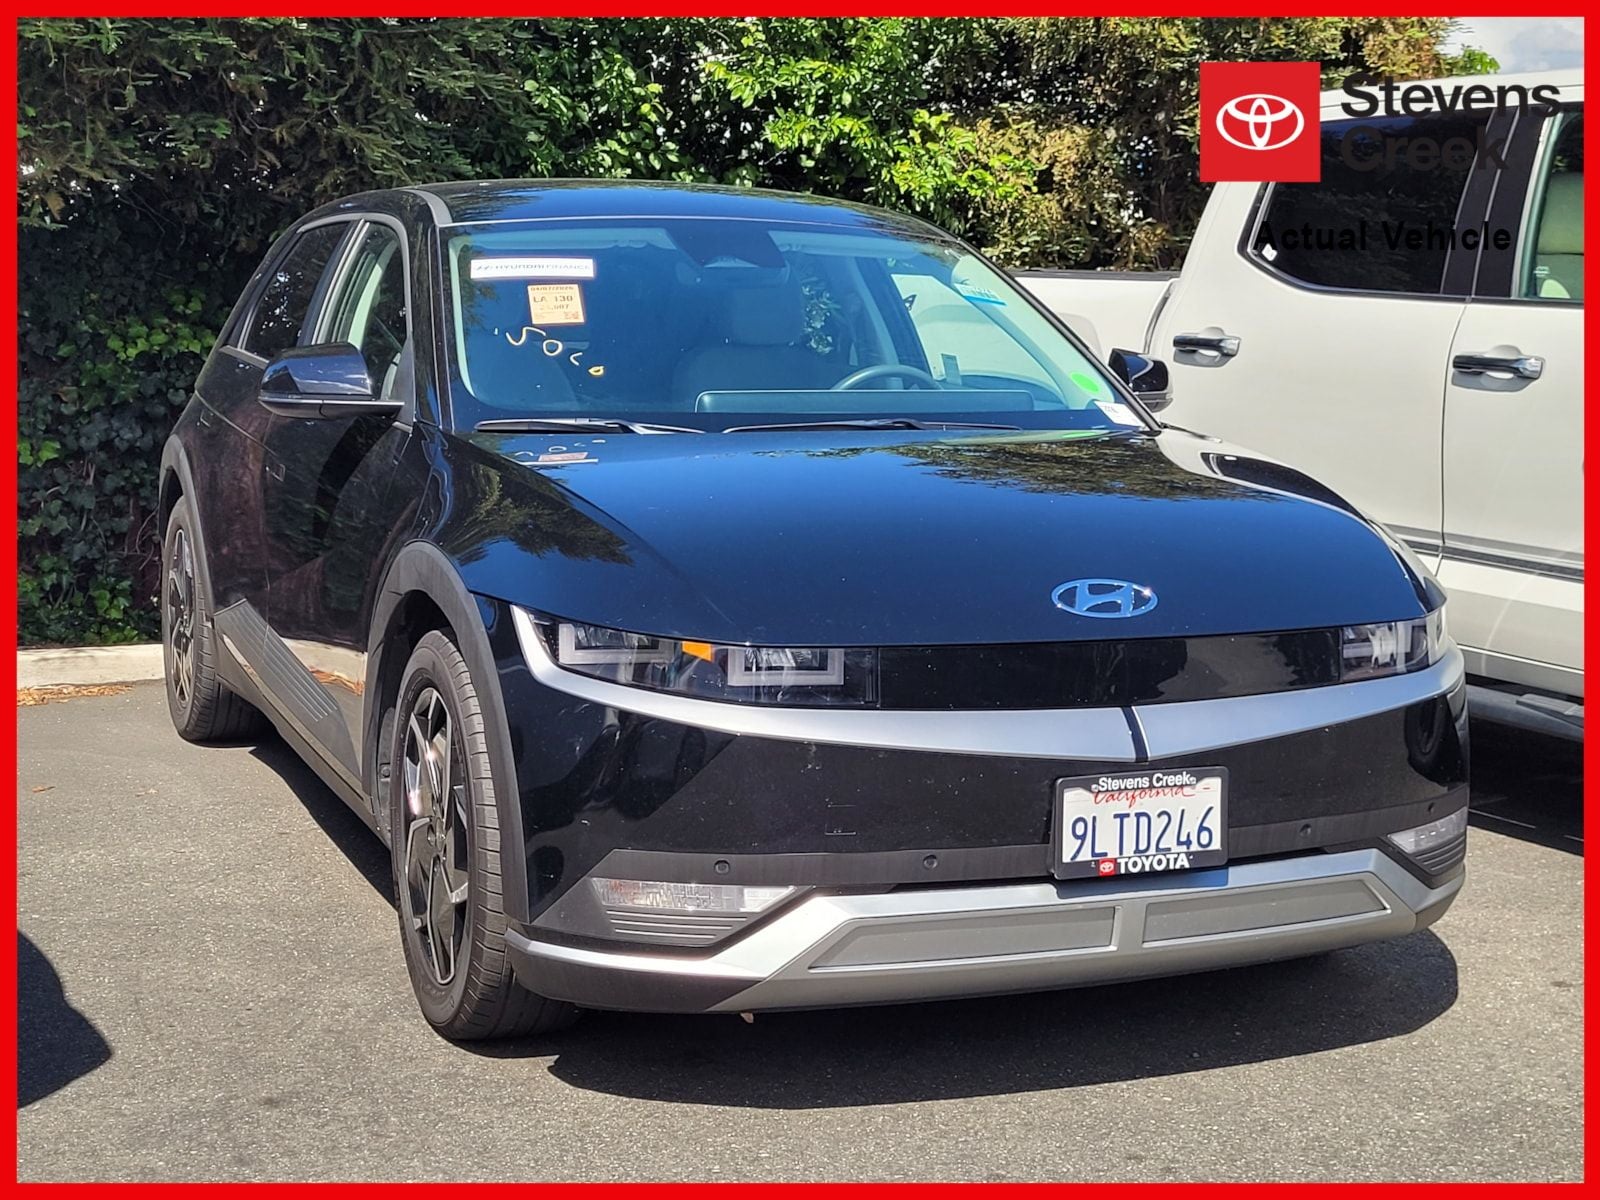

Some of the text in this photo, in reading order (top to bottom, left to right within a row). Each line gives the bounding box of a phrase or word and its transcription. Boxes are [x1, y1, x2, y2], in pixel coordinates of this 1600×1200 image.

[1098, 771, 1191, 792] Stevens Creek
[1093, 784, 1196, 809] California
[1070, 806, 1214, 861] 9LTD246
[1117, 853, 1190, 874] TOYOTA
